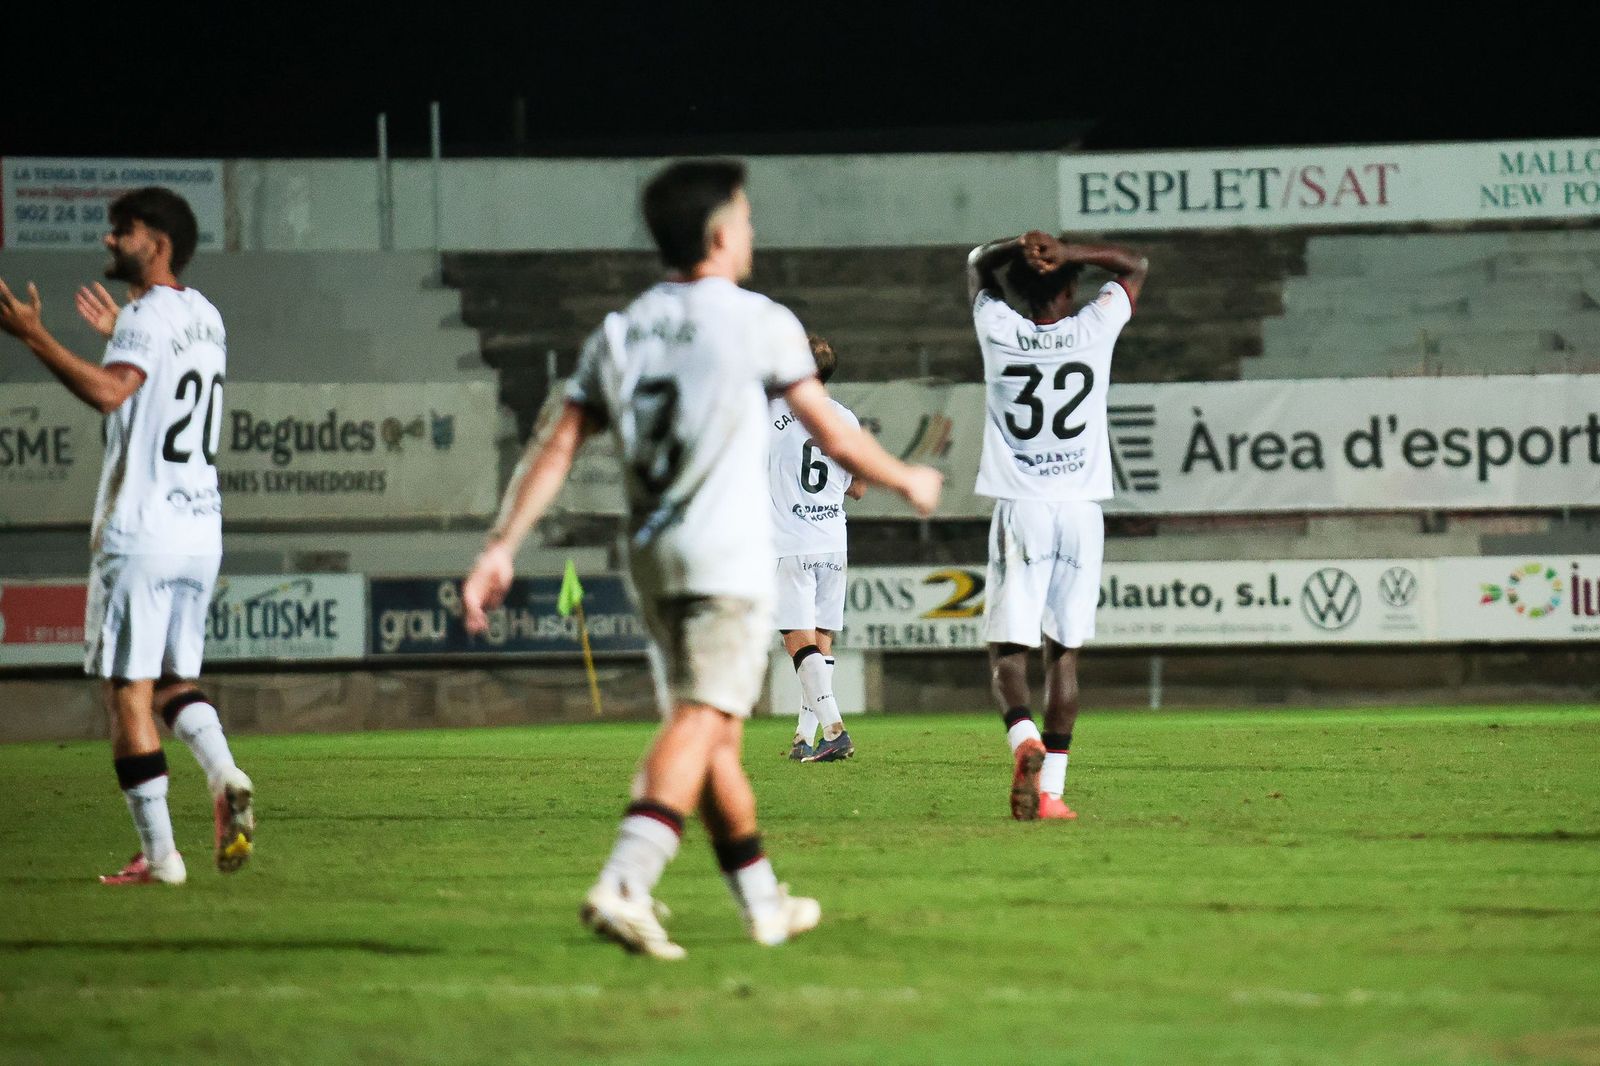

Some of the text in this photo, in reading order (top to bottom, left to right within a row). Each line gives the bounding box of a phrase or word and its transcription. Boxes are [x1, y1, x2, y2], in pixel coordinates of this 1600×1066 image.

[1078, 162, 1399, 215] ESPLET/SAT
[1480, 182, 1549, 208] NEW
[163, 369, 223, 465] 20
[1001, 361, 1094, 440] 32
[231, 408, 376, 466] Begudes
[800, 437, 828, 494] 6
[1180, 406, 1600, 482] Àrea d'esport
[846, 577, 916, 613] ONS
[1237, 573, 1291, 607] s.l.
